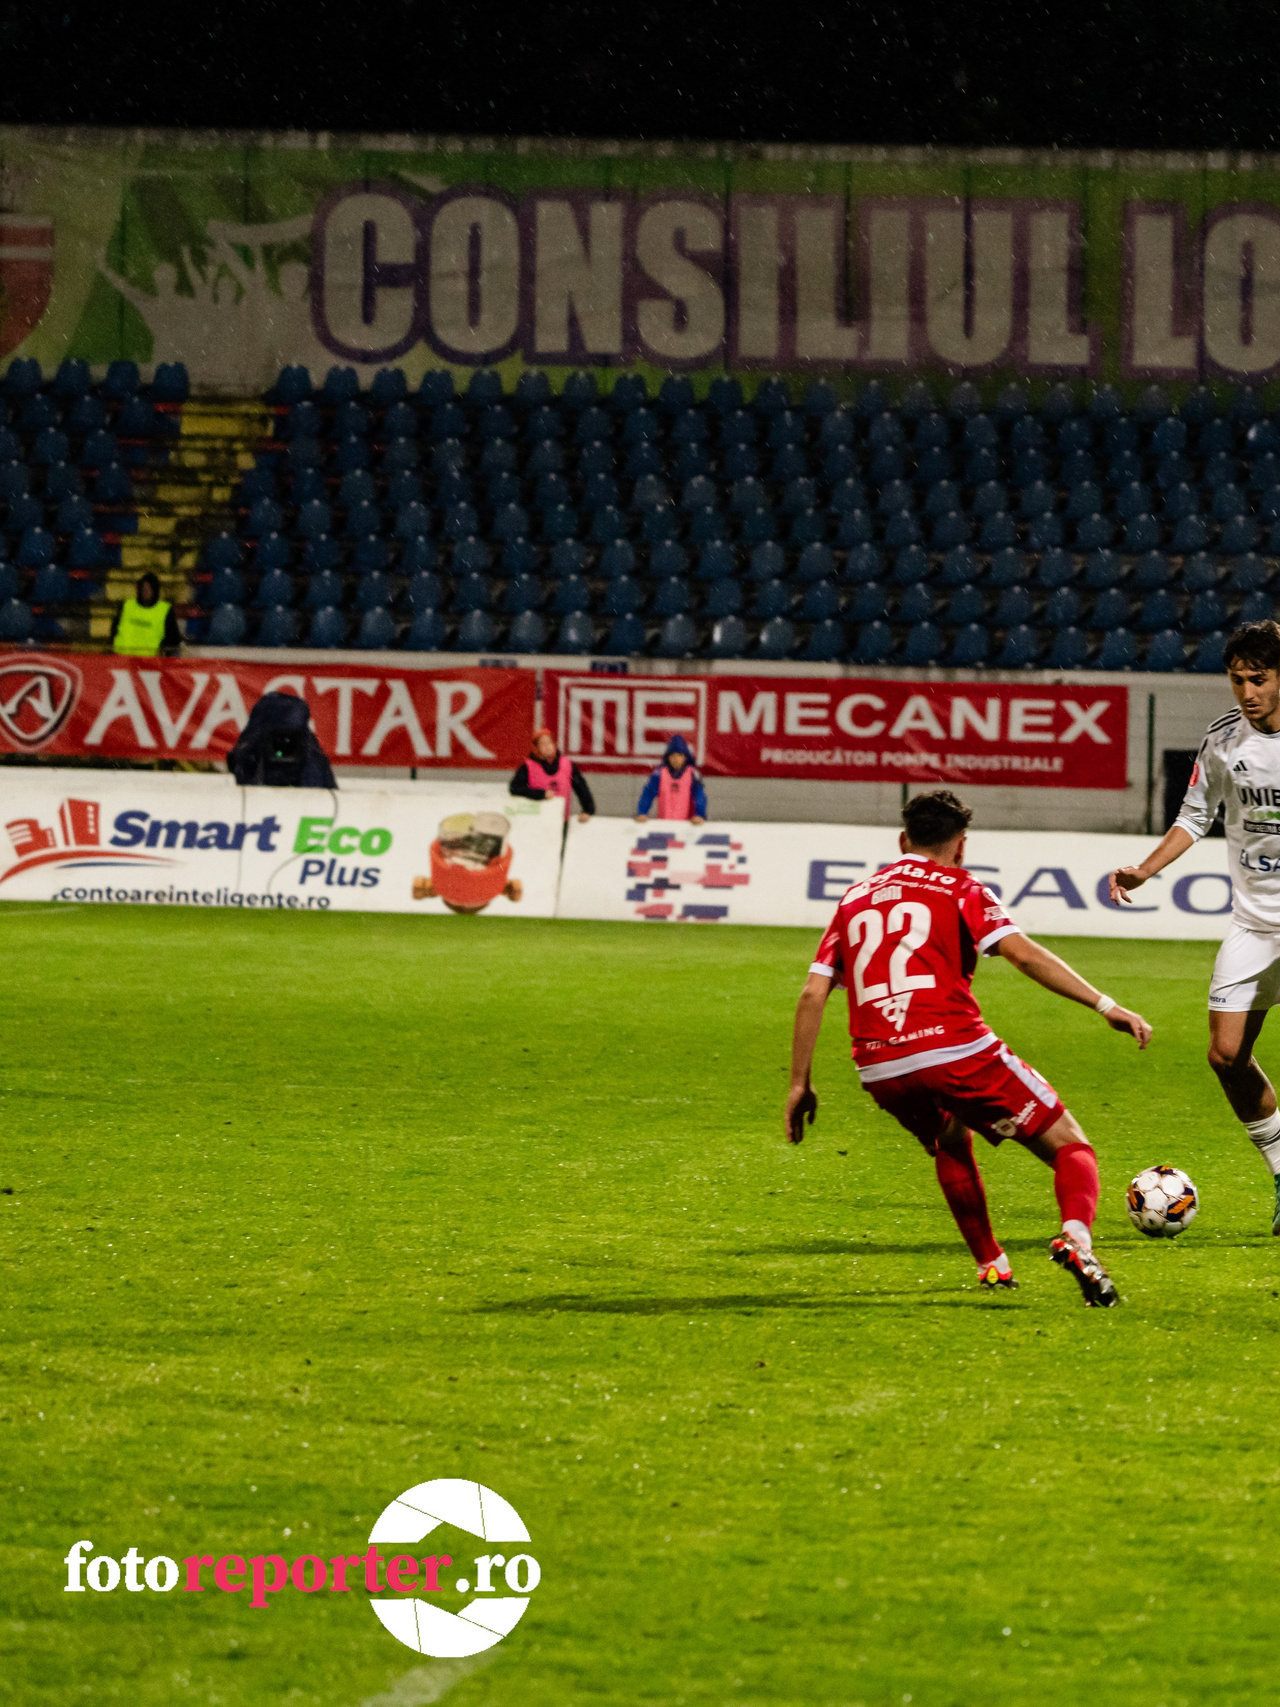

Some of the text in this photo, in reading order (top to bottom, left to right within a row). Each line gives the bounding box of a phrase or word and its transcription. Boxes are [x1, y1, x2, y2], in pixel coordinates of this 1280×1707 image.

[322, 193, 1091, 365] CONSILIUL
[85, 668, 495, 758] AVATAR
[717, 690, 1112, 744] MECANEX
[945, 753, 1064, 772] INDUSTRIALE
[110, 810, 392, 856] Smart Eco
[299, 858, 380, 888] Plus
[847, 901, 936, 1006] 22
[888, 1025, 945, 1045] GAMING
